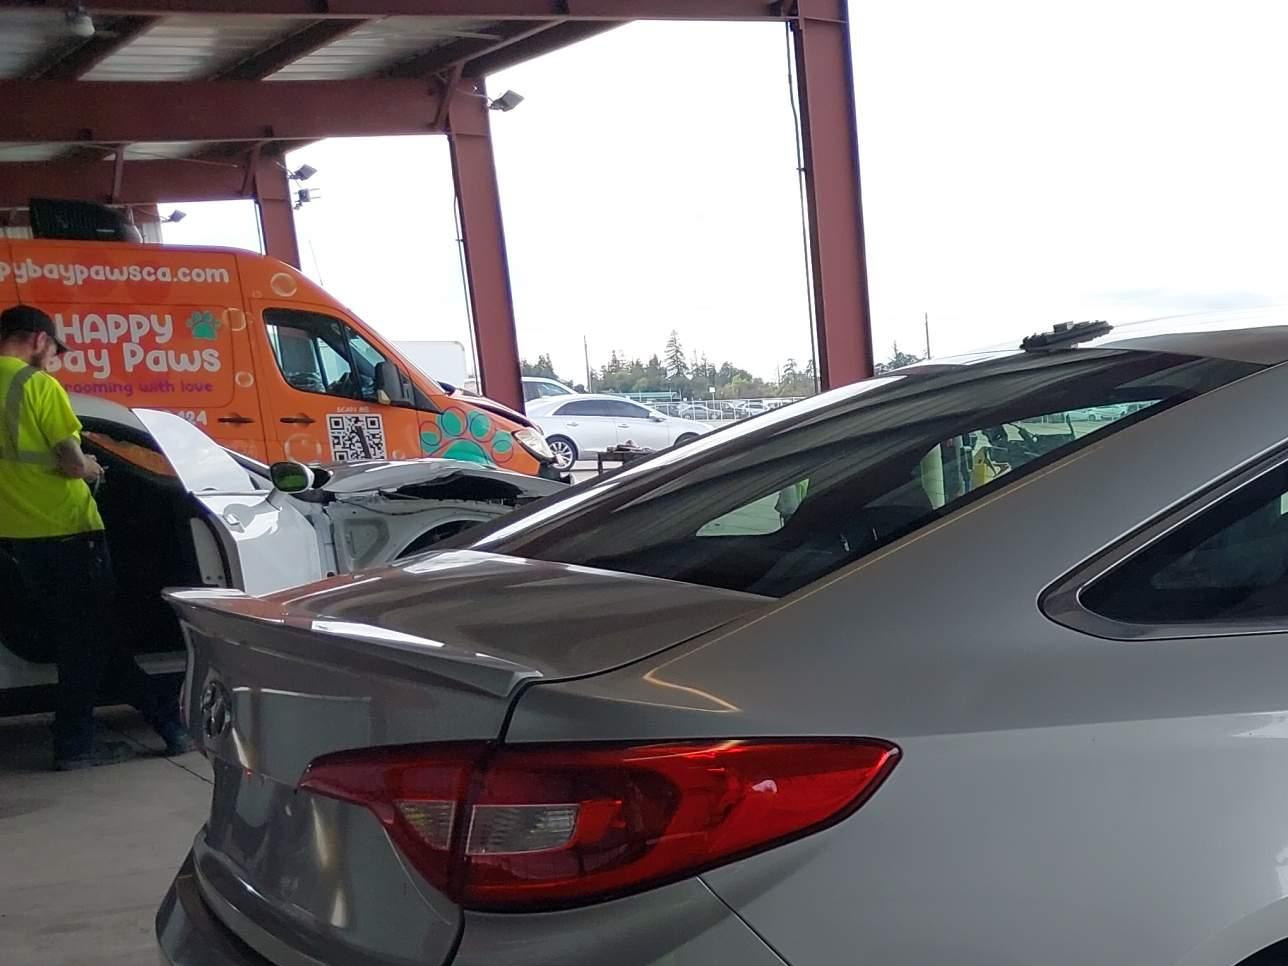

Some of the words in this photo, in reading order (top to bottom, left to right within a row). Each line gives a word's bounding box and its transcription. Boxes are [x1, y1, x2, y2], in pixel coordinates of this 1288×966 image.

[123, 342, 222, 372] Paws
[66, 382, 133, 397] rooming
[139, 381, 175, 393] with
[181, 381, 214, 393] love
